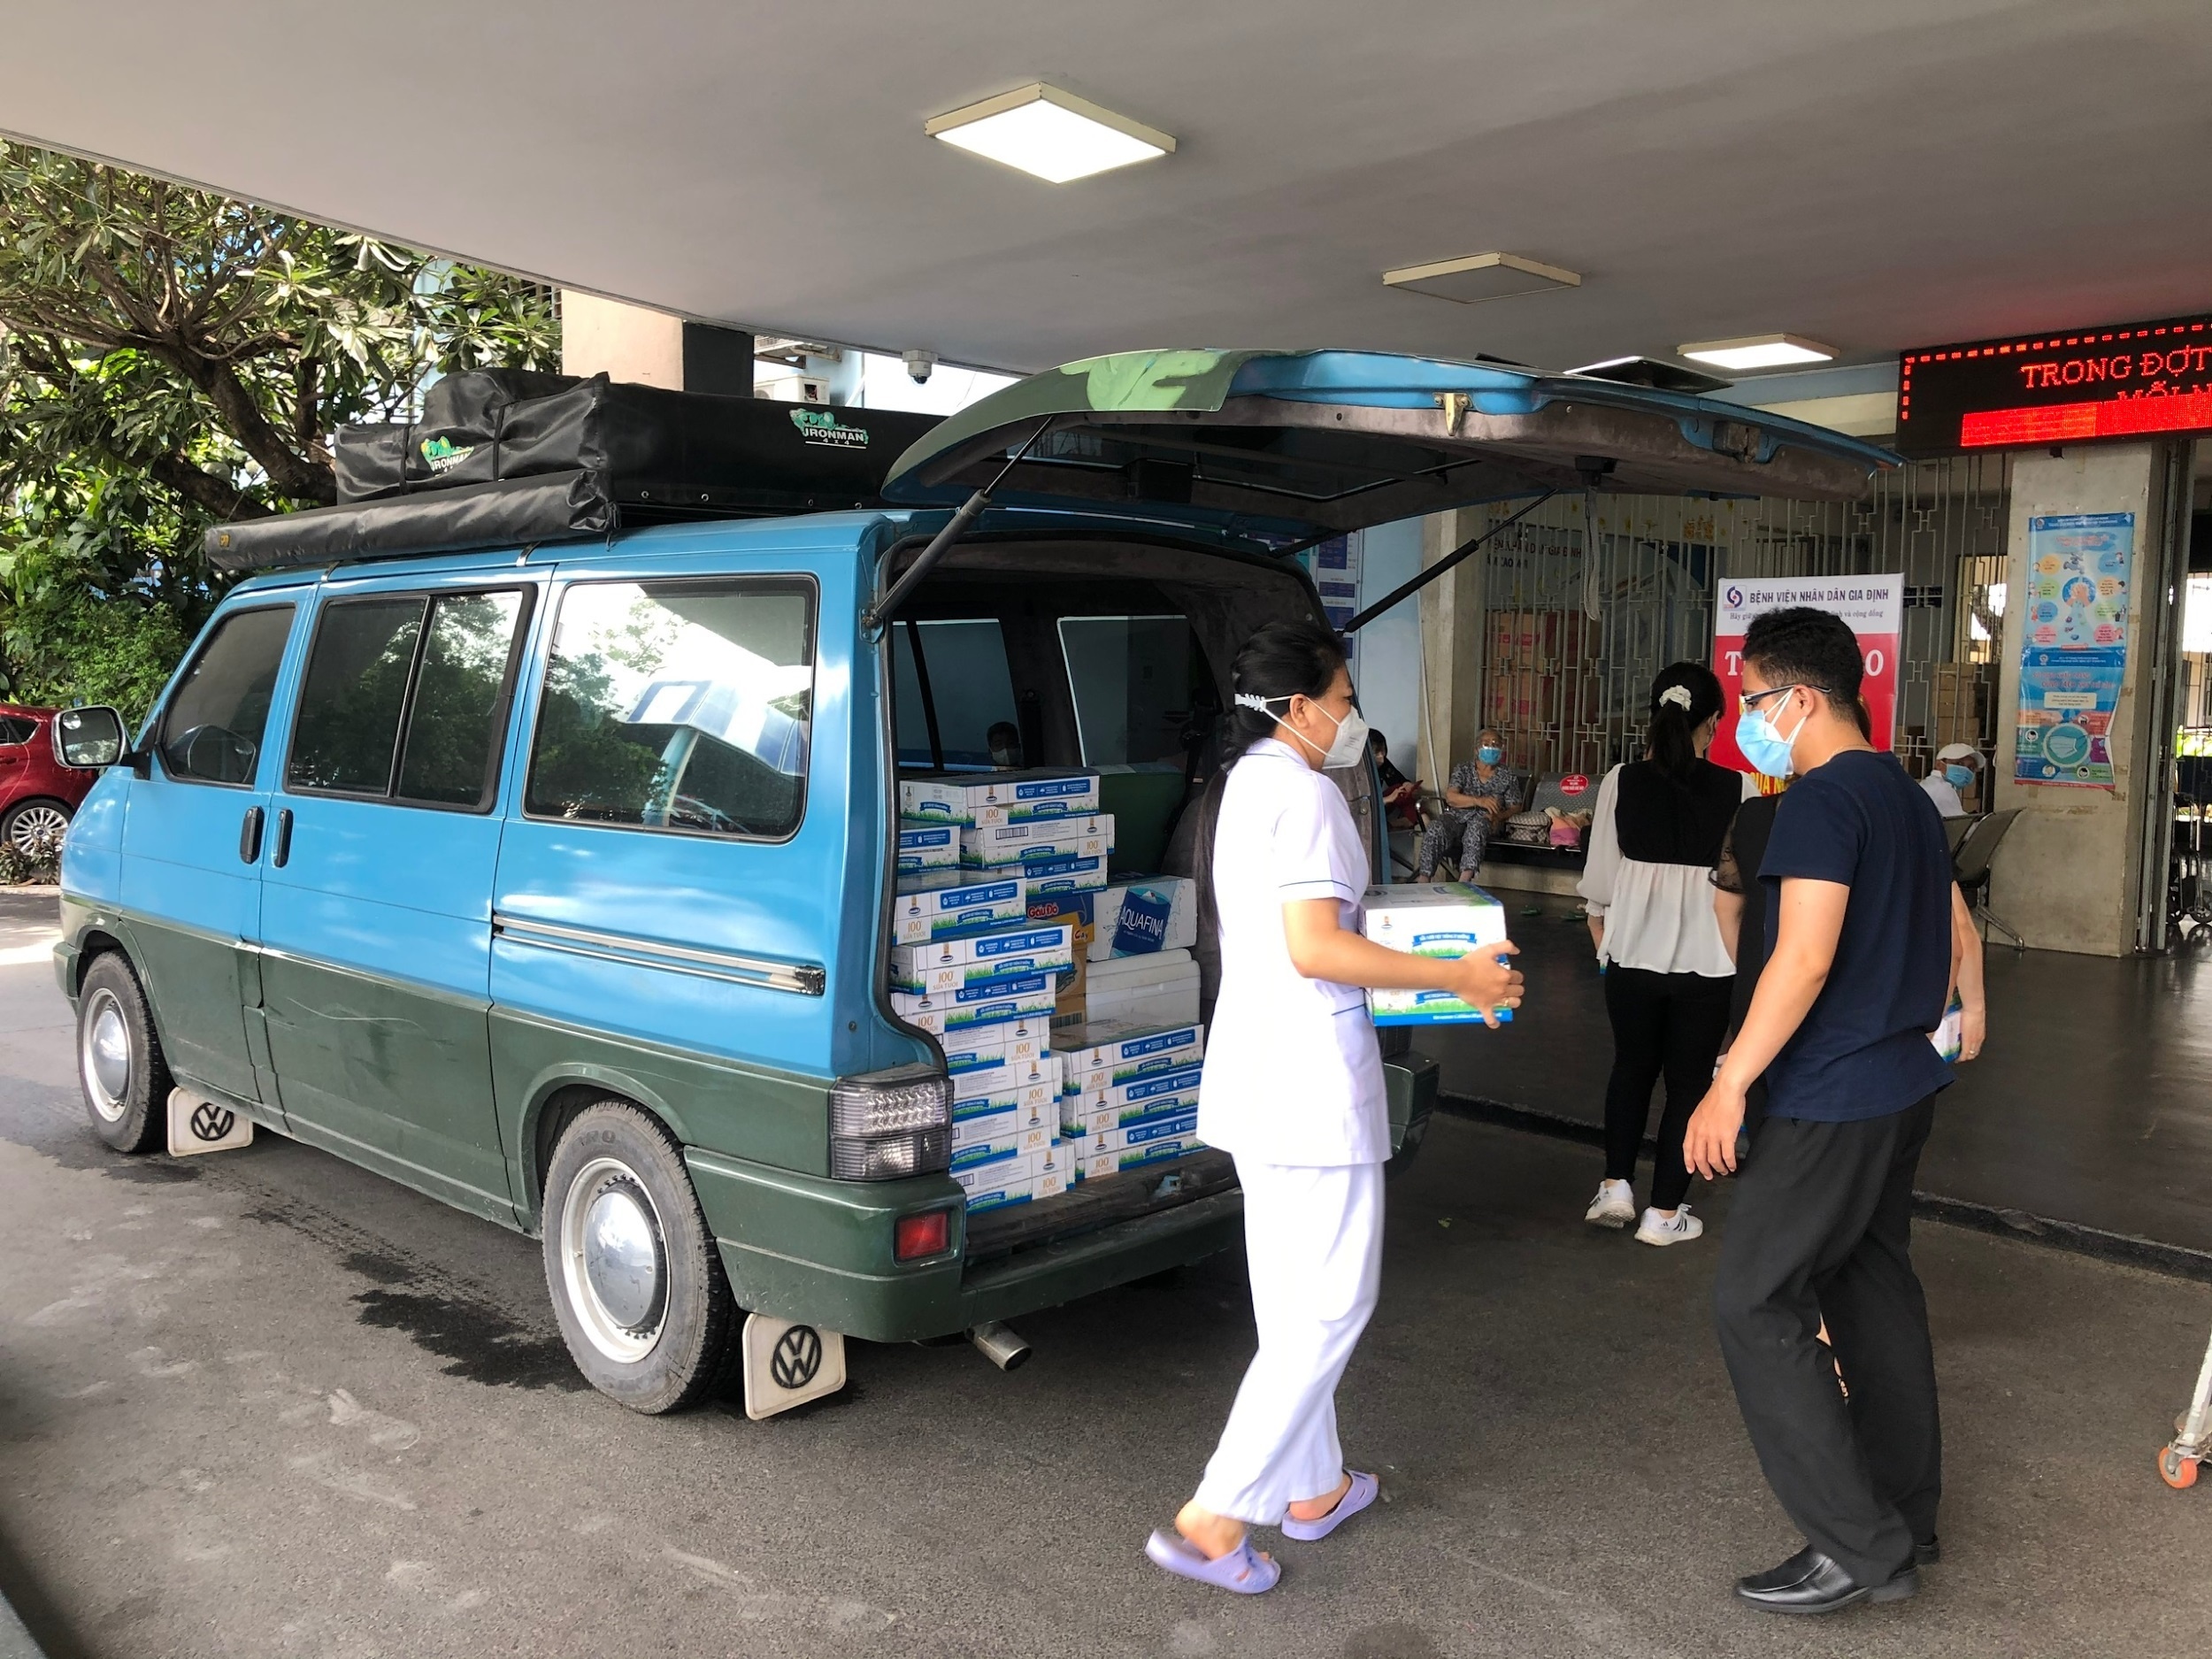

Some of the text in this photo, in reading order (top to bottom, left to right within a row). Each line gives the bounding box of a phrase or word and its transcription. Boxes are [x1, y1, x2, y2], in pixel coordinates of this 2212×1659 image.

[2020, 344, 2212, 388] TRONG ĐỢT
[803, 427, 864, 442] IRONMAN
[1749, 588, 1889, 605] BỆNH VIỆN NHÂN DÂN GIA ĐỊNH
[1118, 906, 1164, 940] AQUAFINA
[772, 1325, 821, 1388] VW
